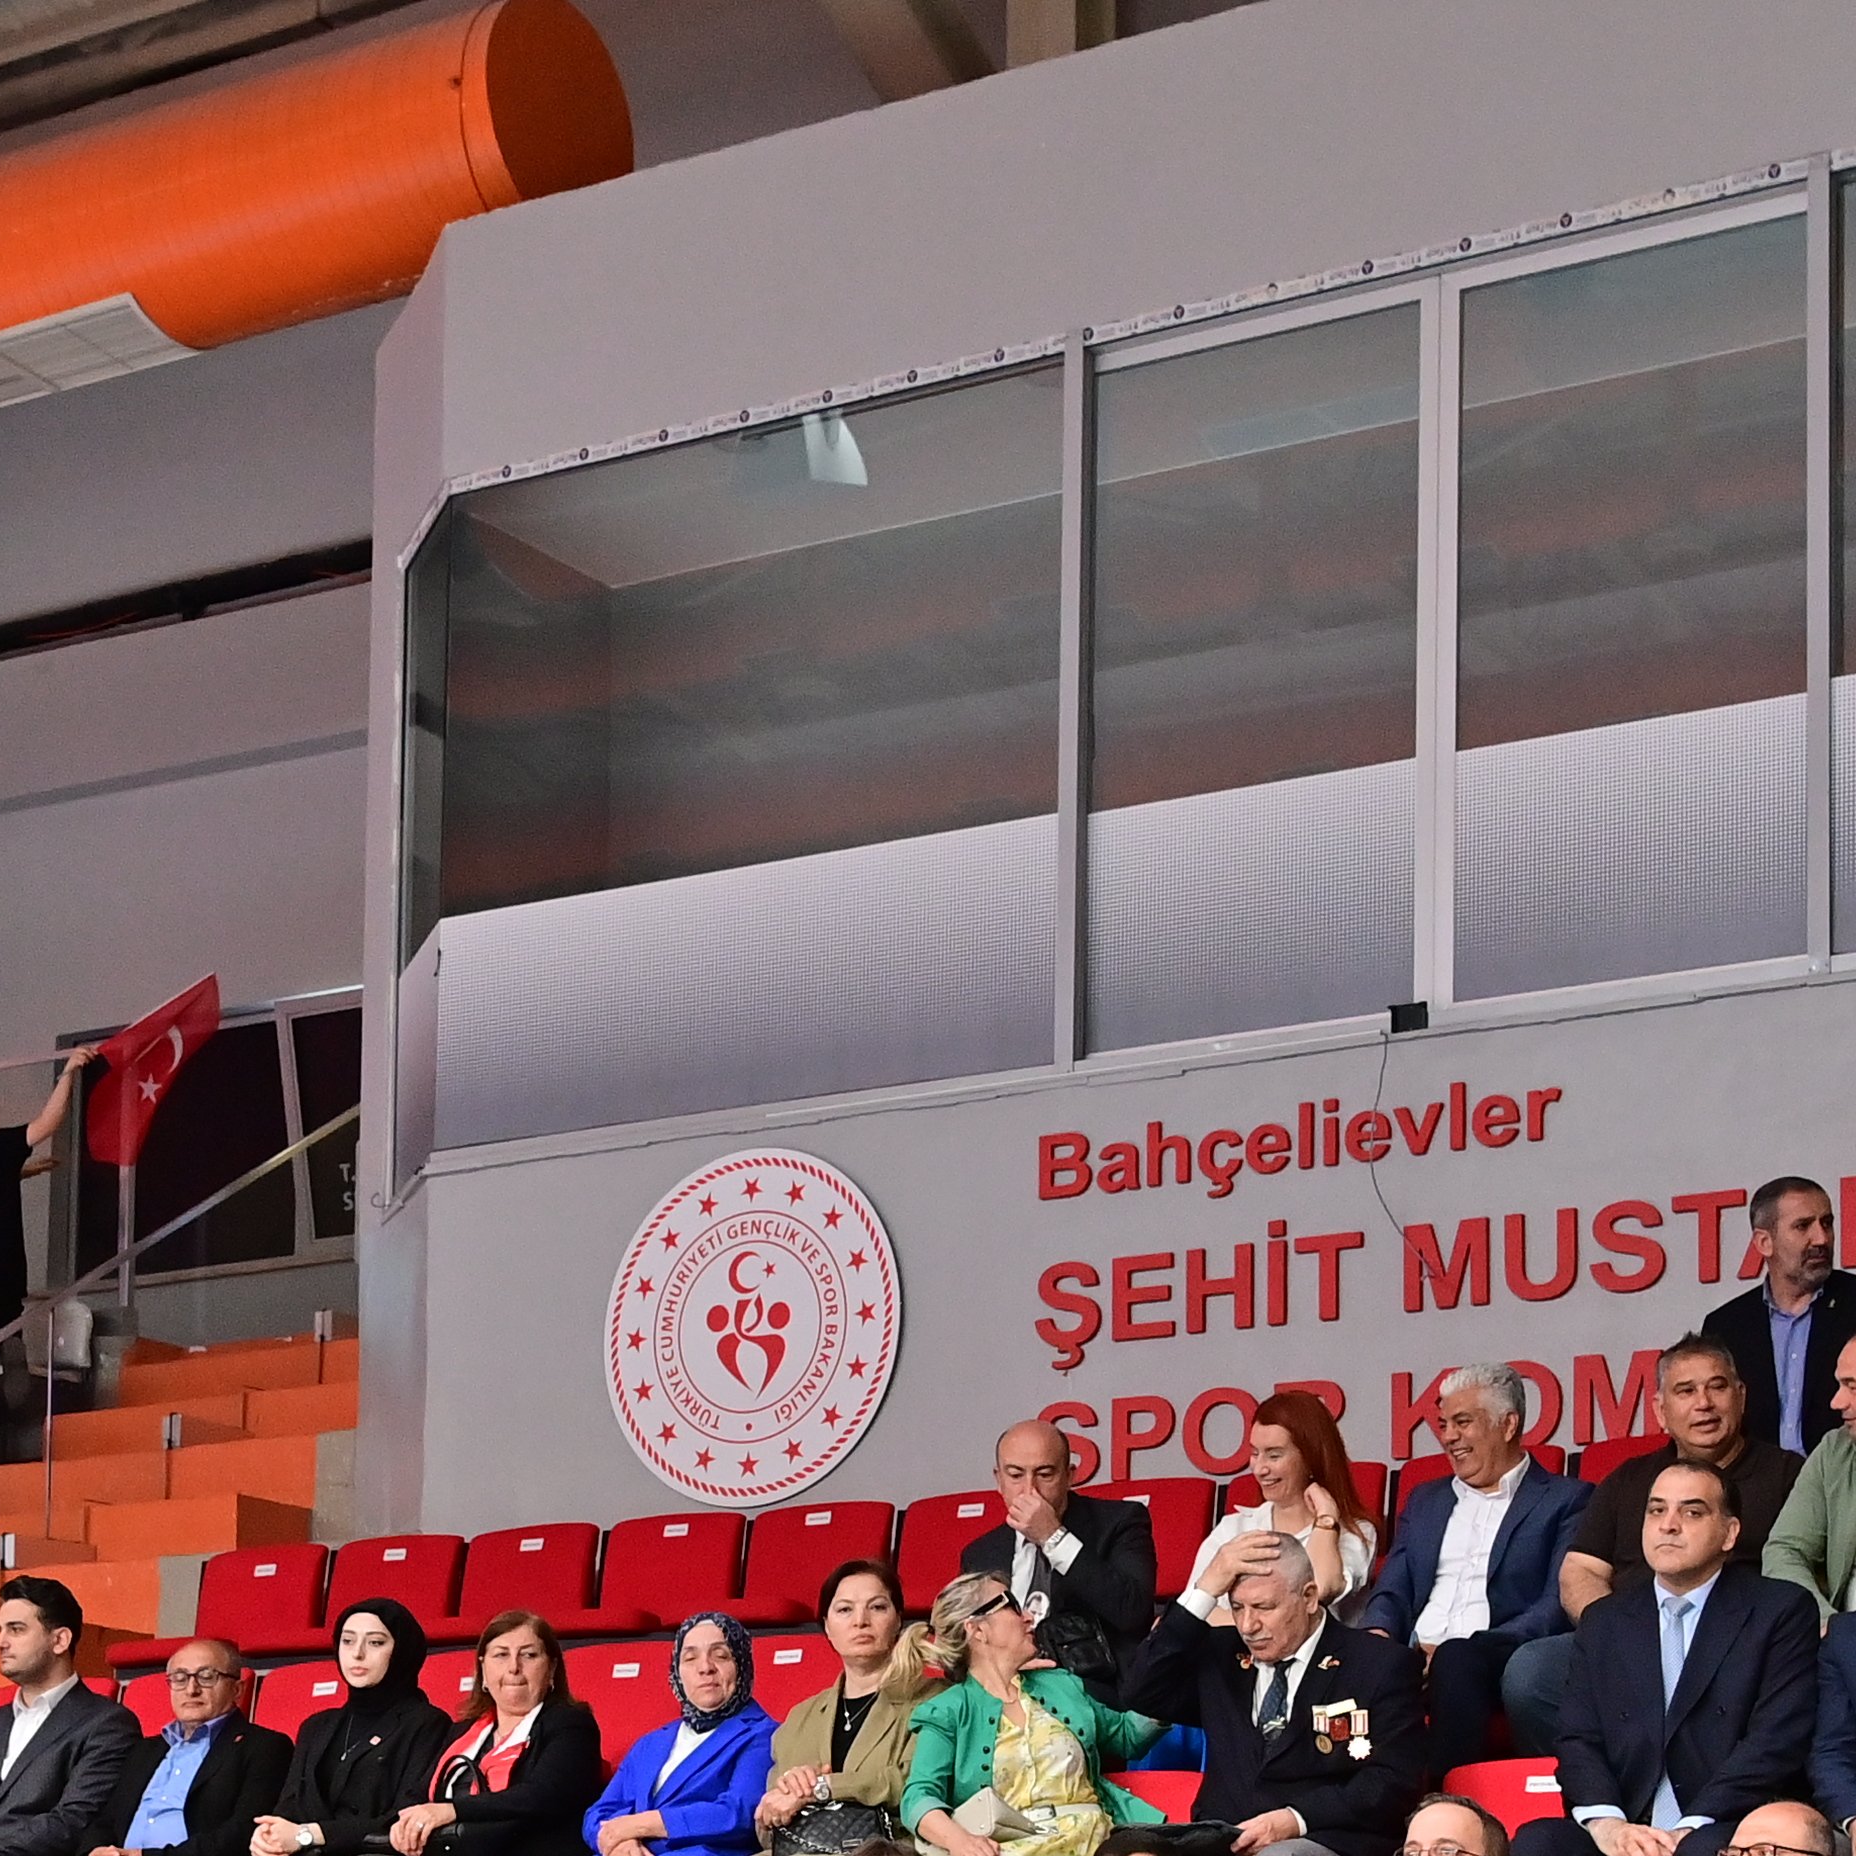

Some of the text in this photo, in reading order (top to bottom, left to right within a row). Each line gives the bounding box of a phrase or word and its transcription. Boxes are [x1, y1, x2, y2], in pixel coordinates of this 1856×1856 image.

[1038, 1081, 1563, 1201] Bahçelievler
[660, 1218, 838, 1430] TÜRKİYE CUMHURİYETİ GENÇLİK VE SPOR BAKANLIĞI
[1034, 1218, 1365, 1371] ŞEHİT
